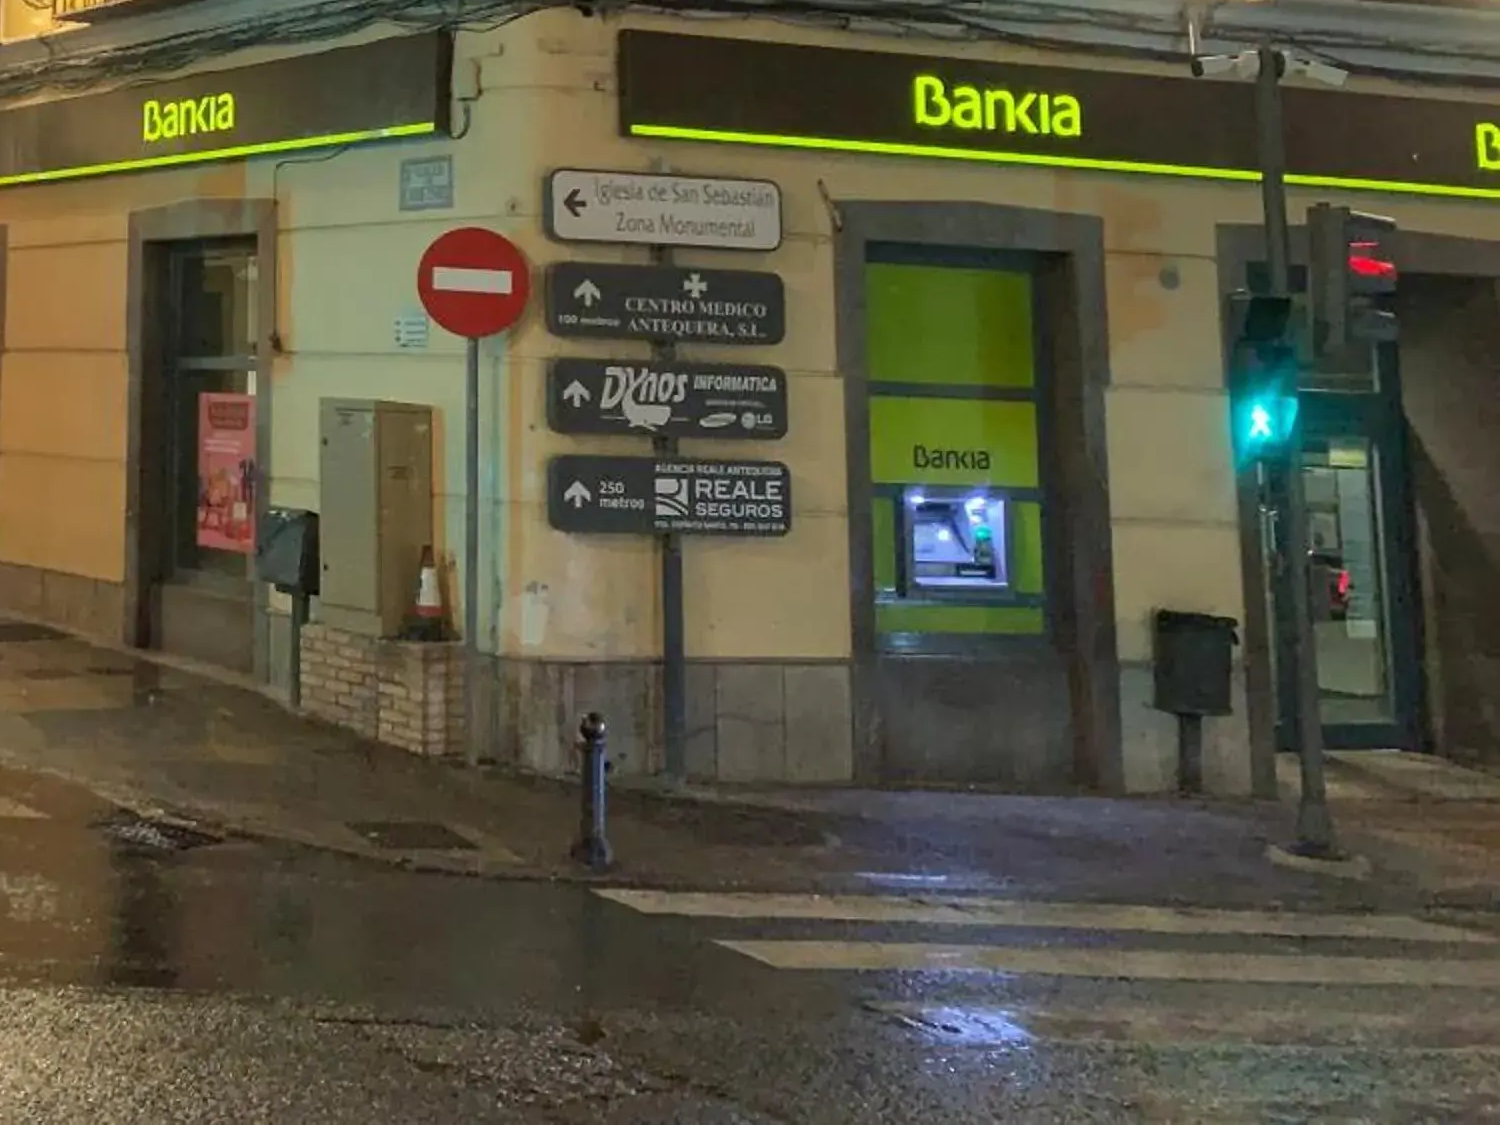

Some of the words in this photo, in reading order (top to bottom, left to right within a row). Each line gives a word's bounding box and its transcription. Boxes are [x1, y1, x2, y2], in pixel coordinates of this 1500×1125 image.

[143, 92, 235, 142] Bankia
[913, 75, 1082, 137] Bankia
[596, 179, 644, 205] Iglesia
[649, 185, 667, 202] de
[672, 183, 700, 204] San
[615, 211, 656, 234] Zona
[660, 213, 756, 238] Monumental
[625, 297, 695, 315] CENTRO
[913, 445, 990, 470] Bankia
[600, 481, 625, 493] 250
[695, 479, 784, 501] REALE
[600, 496, 645, 509] metros
[695, 502, 784, 519] SEGUROS
